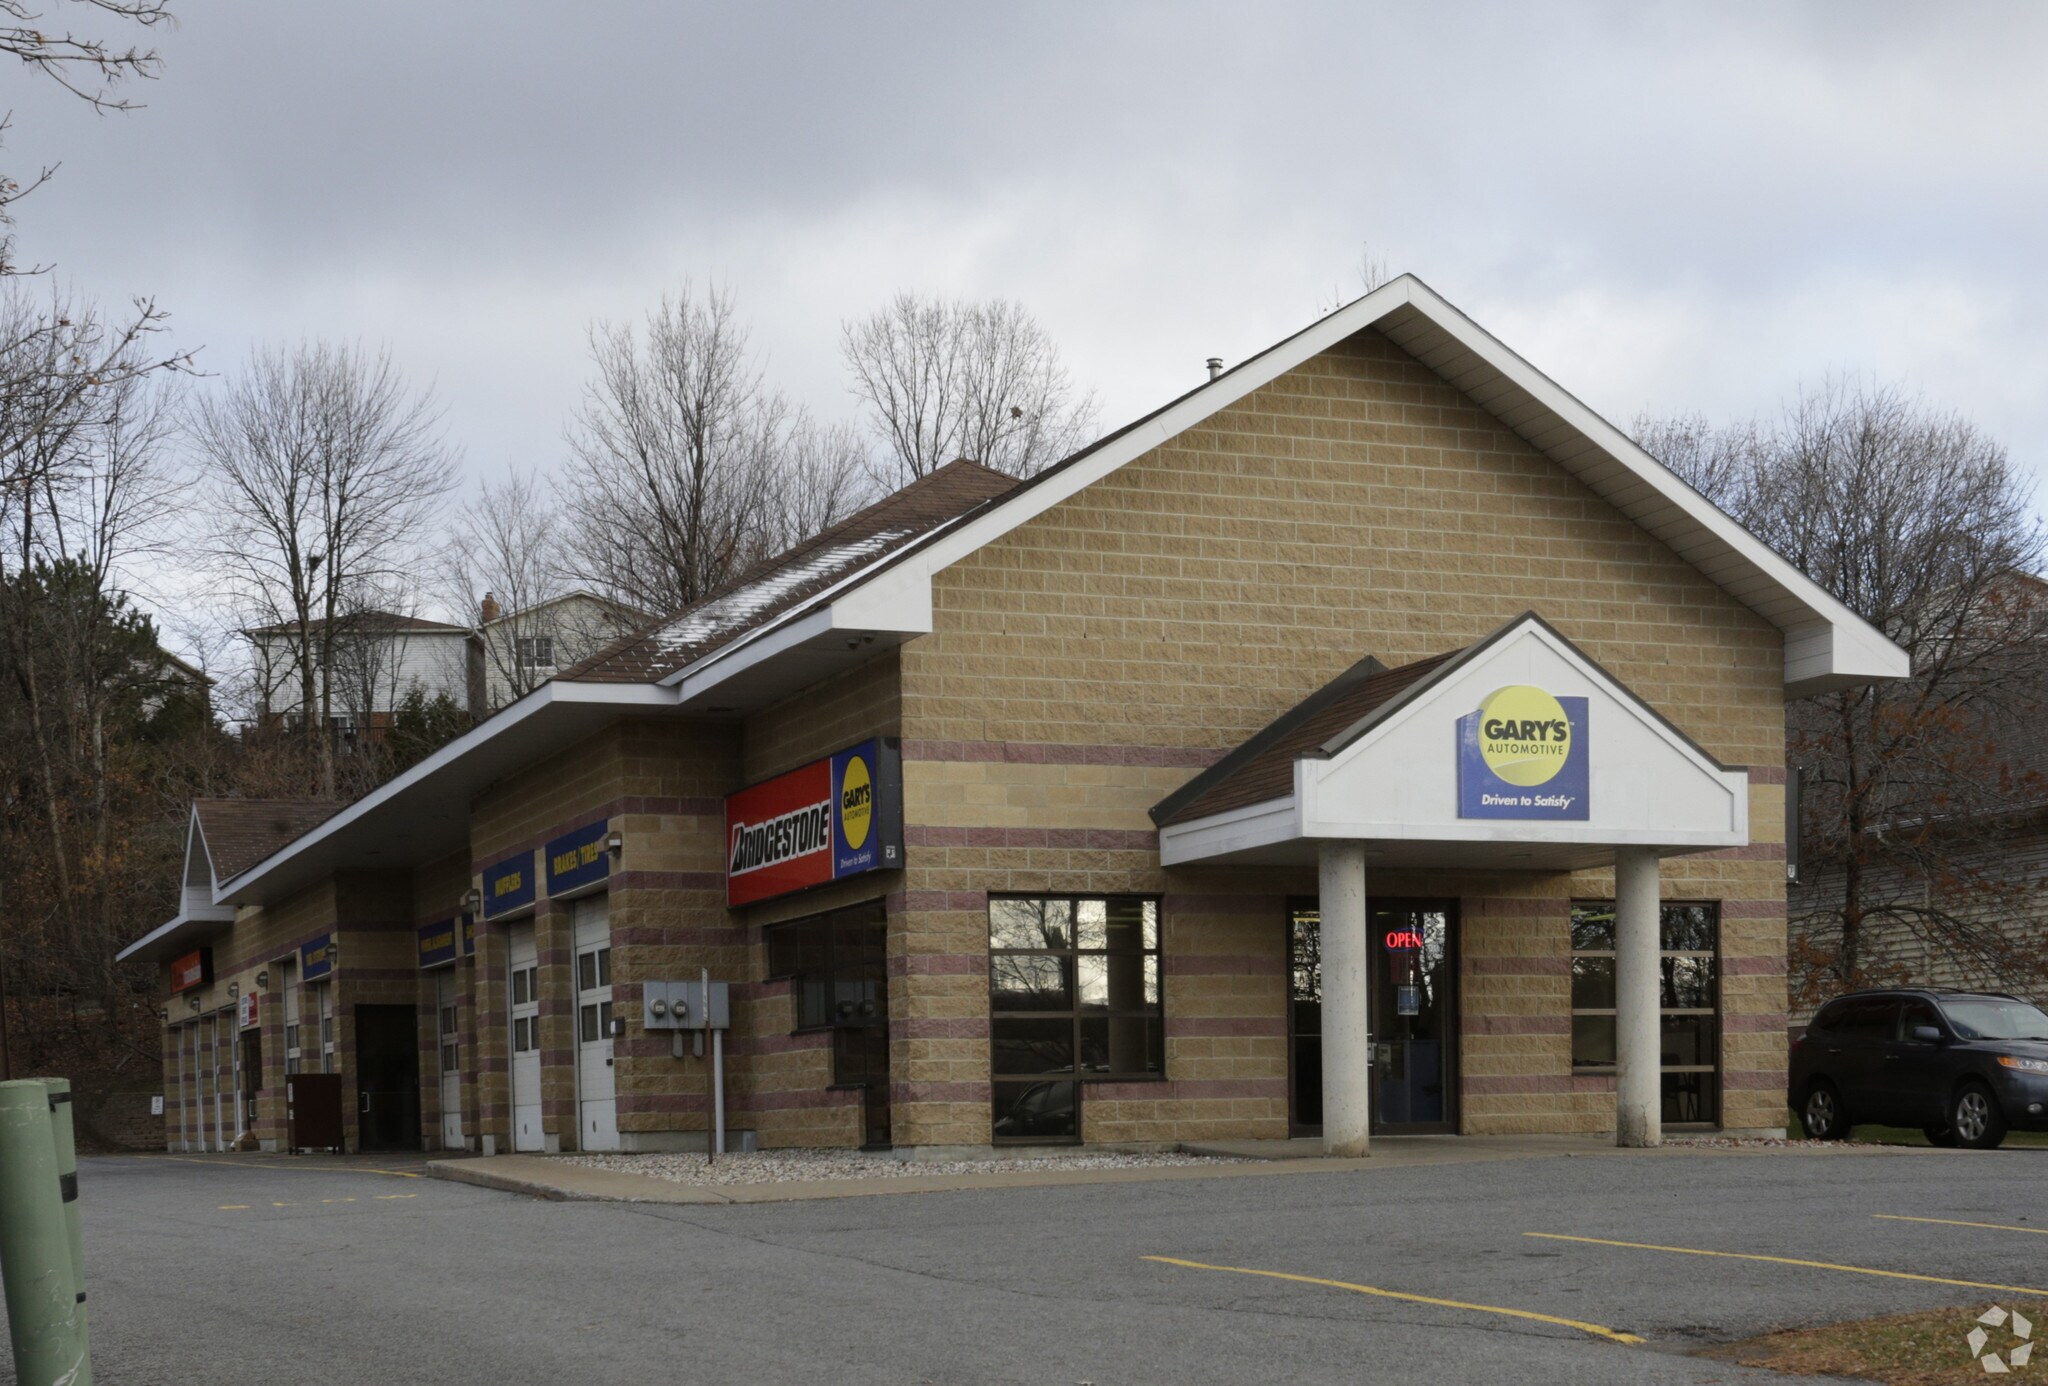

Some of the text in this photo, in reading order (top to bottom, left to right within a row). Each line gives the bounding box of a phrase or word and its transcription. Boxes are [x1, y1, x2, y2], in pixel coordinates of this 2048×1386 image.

[1484, 719, 1567, 742] GARY'S
[1487, 743, 1564, 755] AUTOMOTIVE
[843, 784, 870, 809] GARY'S
[1482, 794, 1571, 810] Driven to Satisfy
[844, 807, 870, 820] AUTOMOTIVE
[730, 801, 831, 876] BRIDGESTONE
[1386, 931, 1422, 948] OPEN
